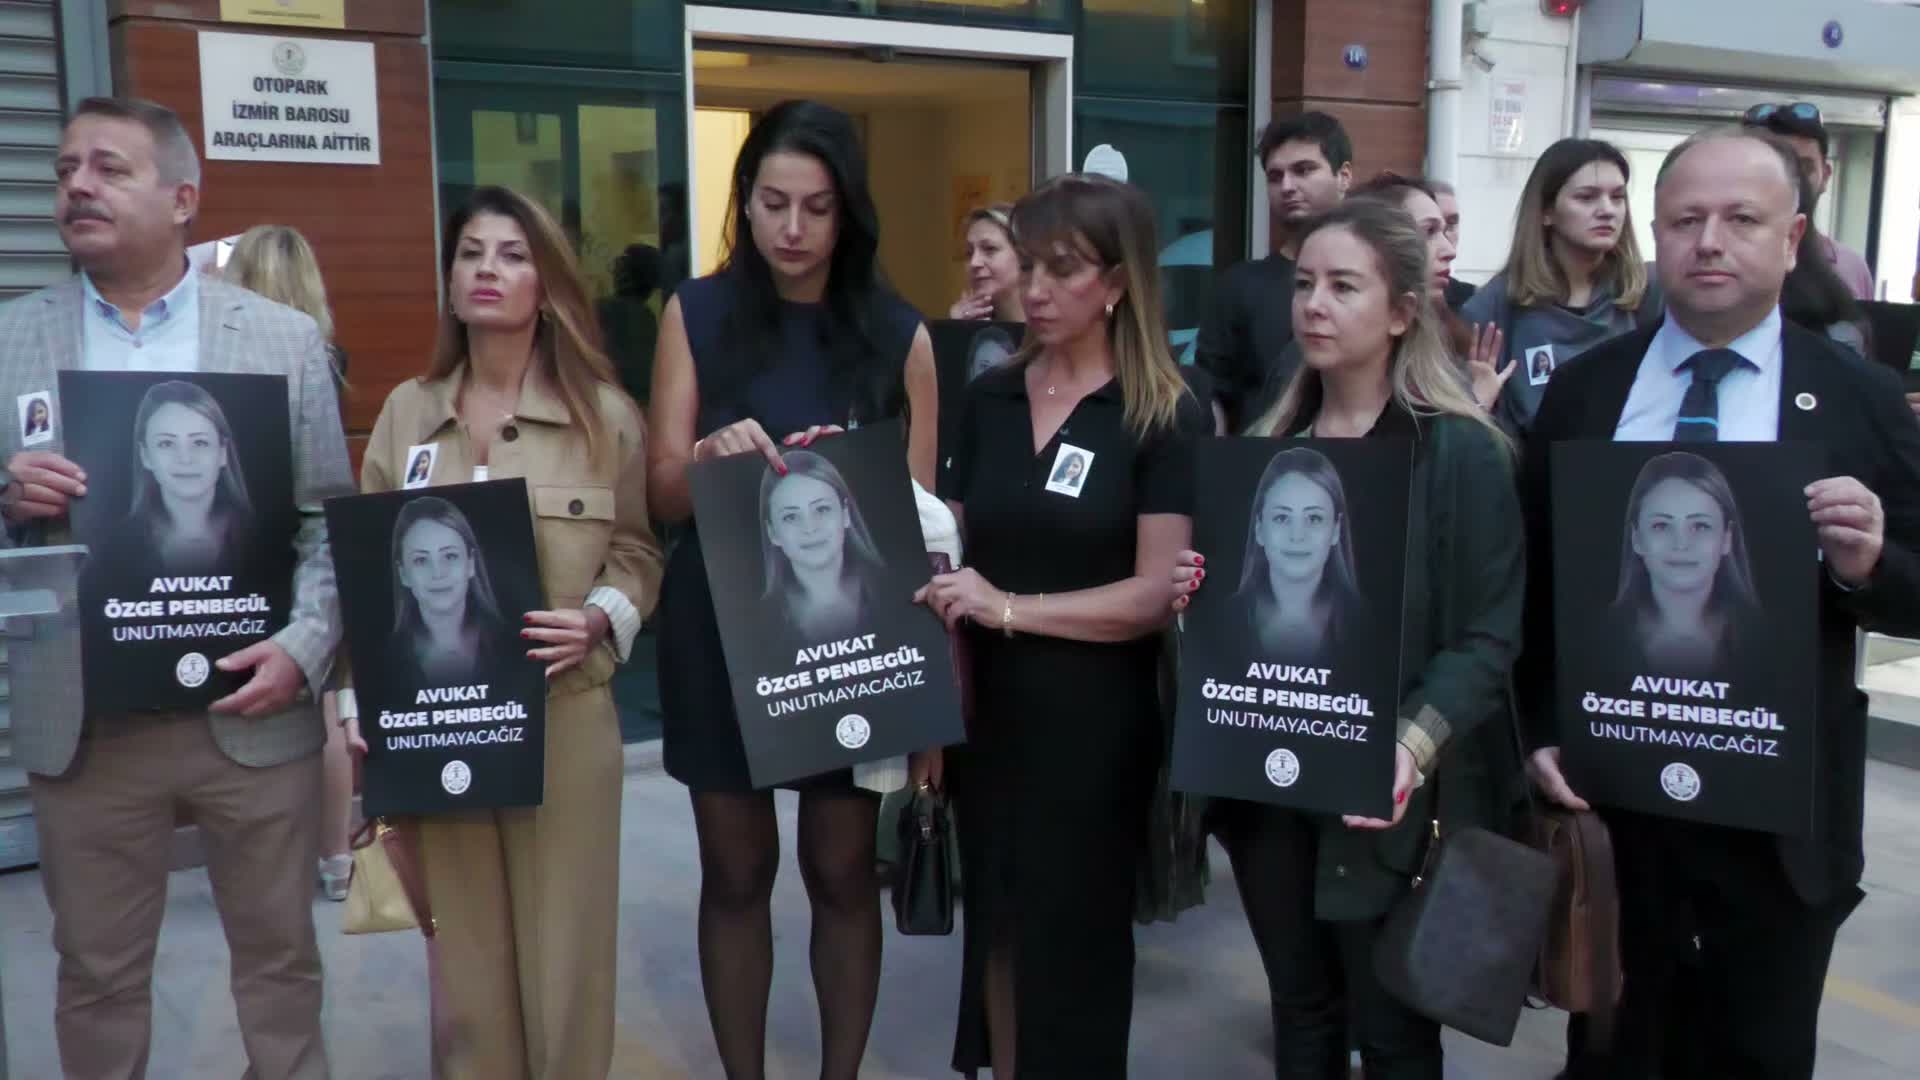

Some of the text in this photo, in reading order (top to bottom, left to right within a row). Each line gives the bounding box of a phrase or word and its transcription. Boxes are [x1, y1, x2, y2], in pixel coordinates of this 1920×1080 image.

[253, 76, 328, 95] OTOPARK
[232, 100, 350, 123] İZMİR BAROSU
[213, 131, 371, 152] ARAÇLARINA AİTTİR
[150, 576, 232, 593] AVUKAT
[104, 594, 270, 618] ÖZGE PENBEGÜL
[112, 618, 265, 641] UNUTMAYACAĞIZ
[795, 633, 876, 665] AVUKAT
[756, 645, 925, 696] ÖZGE PENBEGÜL
[1246, 662, 1331, 686] AVUKAT
[415, 684, 489, 704] AVUKAT
[767, 670, 925, 717] UNUTMAYACAĞIZ
[1202, 678, 1374, 717] ÖZGE PENBEGÜL
[1631, 675, 1730, 700] AVUKAT
[379, 701, 527, 729] ÖZGE PENBEGÜL
[1582, 692, 1784, 731] ÖZGE PENBEGÜL
[1207, 708, 1368, 742] UNUTMAYACAĞIZ
[387, 726, 523, 750] UNUTMAYACAĞIZ
[1590, 721, 1779, 757] UNUTMAYACAĞIZ
